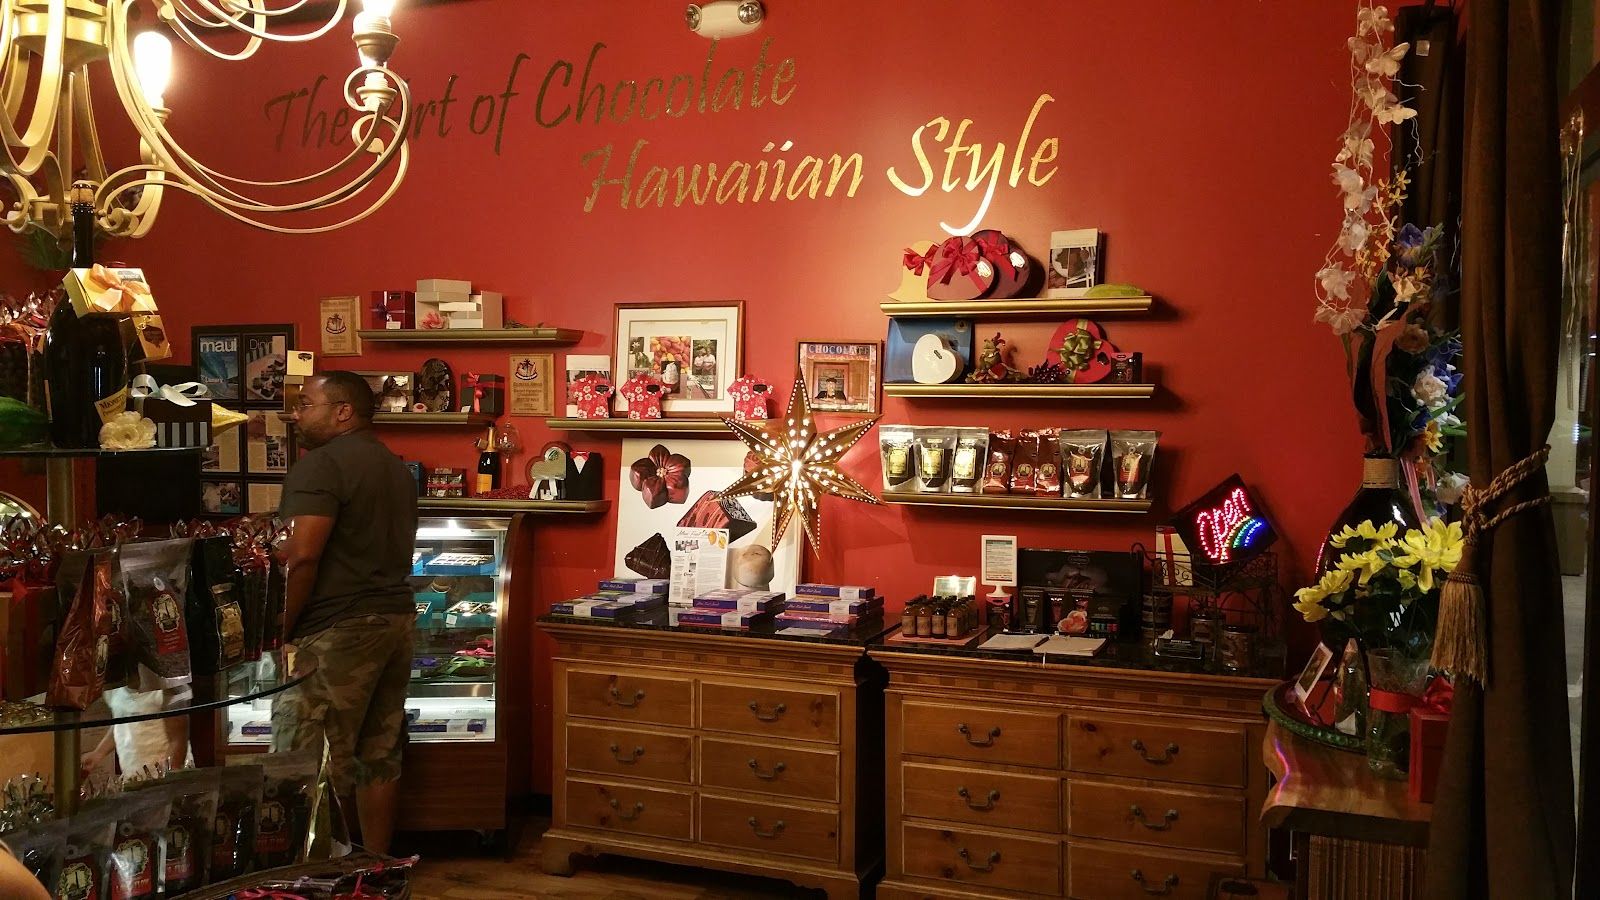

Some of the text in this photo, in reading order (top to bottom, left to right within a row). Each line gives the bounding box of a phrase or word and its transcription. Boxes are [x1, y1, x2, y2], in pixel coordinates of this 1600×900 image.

[264, 74, 350, 151] The
[468, 53, 531, 156] of
[535, 39, 797, 129] Chocolate
[583, 93, 1059, 237] Hawaiian Style
[200, 337, 237, 352] maui
[808, 344, 869, 355] CHOCOLATE
[1196, 487, 1251, 564] Open
